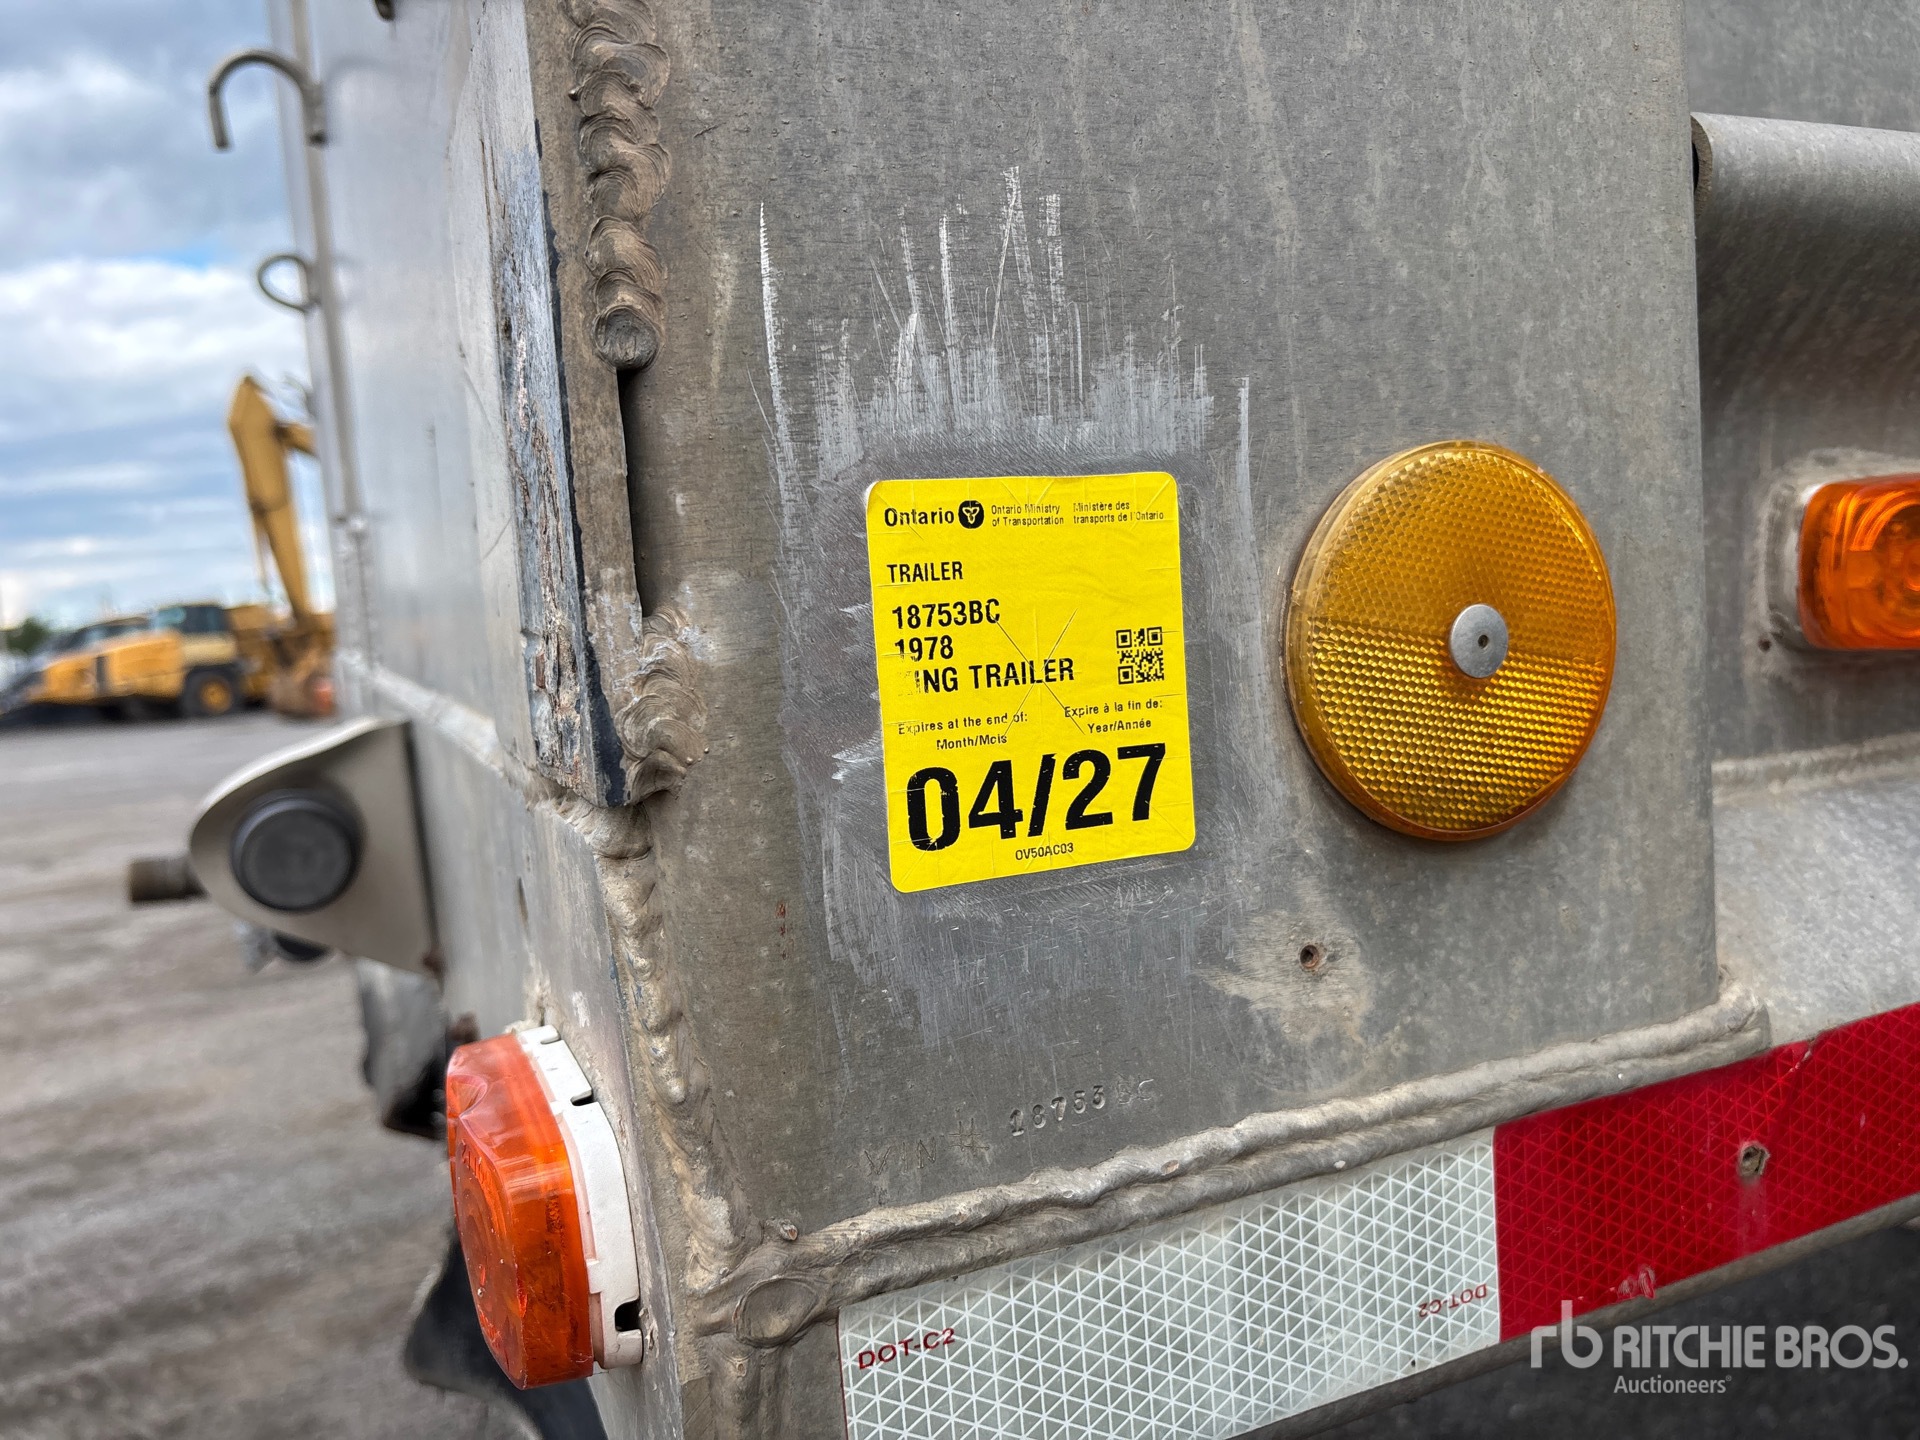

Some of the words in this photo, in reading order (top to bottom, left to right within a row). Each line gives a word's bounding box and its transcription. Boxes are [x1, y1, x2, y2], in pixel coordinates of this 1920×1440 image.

[991, 504, 1022, 515] Ontario
[1025, 503, 1061, 517] Ministry
[1115, 501, 1130, 511] des
[884, 508, 955, 527] Ontario
[991, 518, 1000, 527] of
[1003, 516, 1064, 528] Transportation
[1073, 513, 1115, 525] transports
[1117, 513, 1128, 522] de
[887, 561, 963, 583] TRAILER
[892, 598, 1000, 629] 18753BC
[895, 635, 954, 662] 1978
[968, 657, 1075, 688] TRAILER
[1064, 704, 1100, 718] Expire
[1103, 702, 1110, 714] à
[1114, 701, 1124, 713] la
[1127, 700, 1142, 710] fin
[1146, 698, 1164, 709] de:
[898, 721, 943, 736] Expires
[947, 718, 959, 729] at
[963, 716, 982, 727] the
[986, 713, 1008, 724] end
[1087, 718, 1152, 734] Year/Année
[906, 743, 1166, 851] 04/27
[1418, 1283, 1487, 1317] DOT-C2
[858, 1328, 955, 1369] DOT-C2
